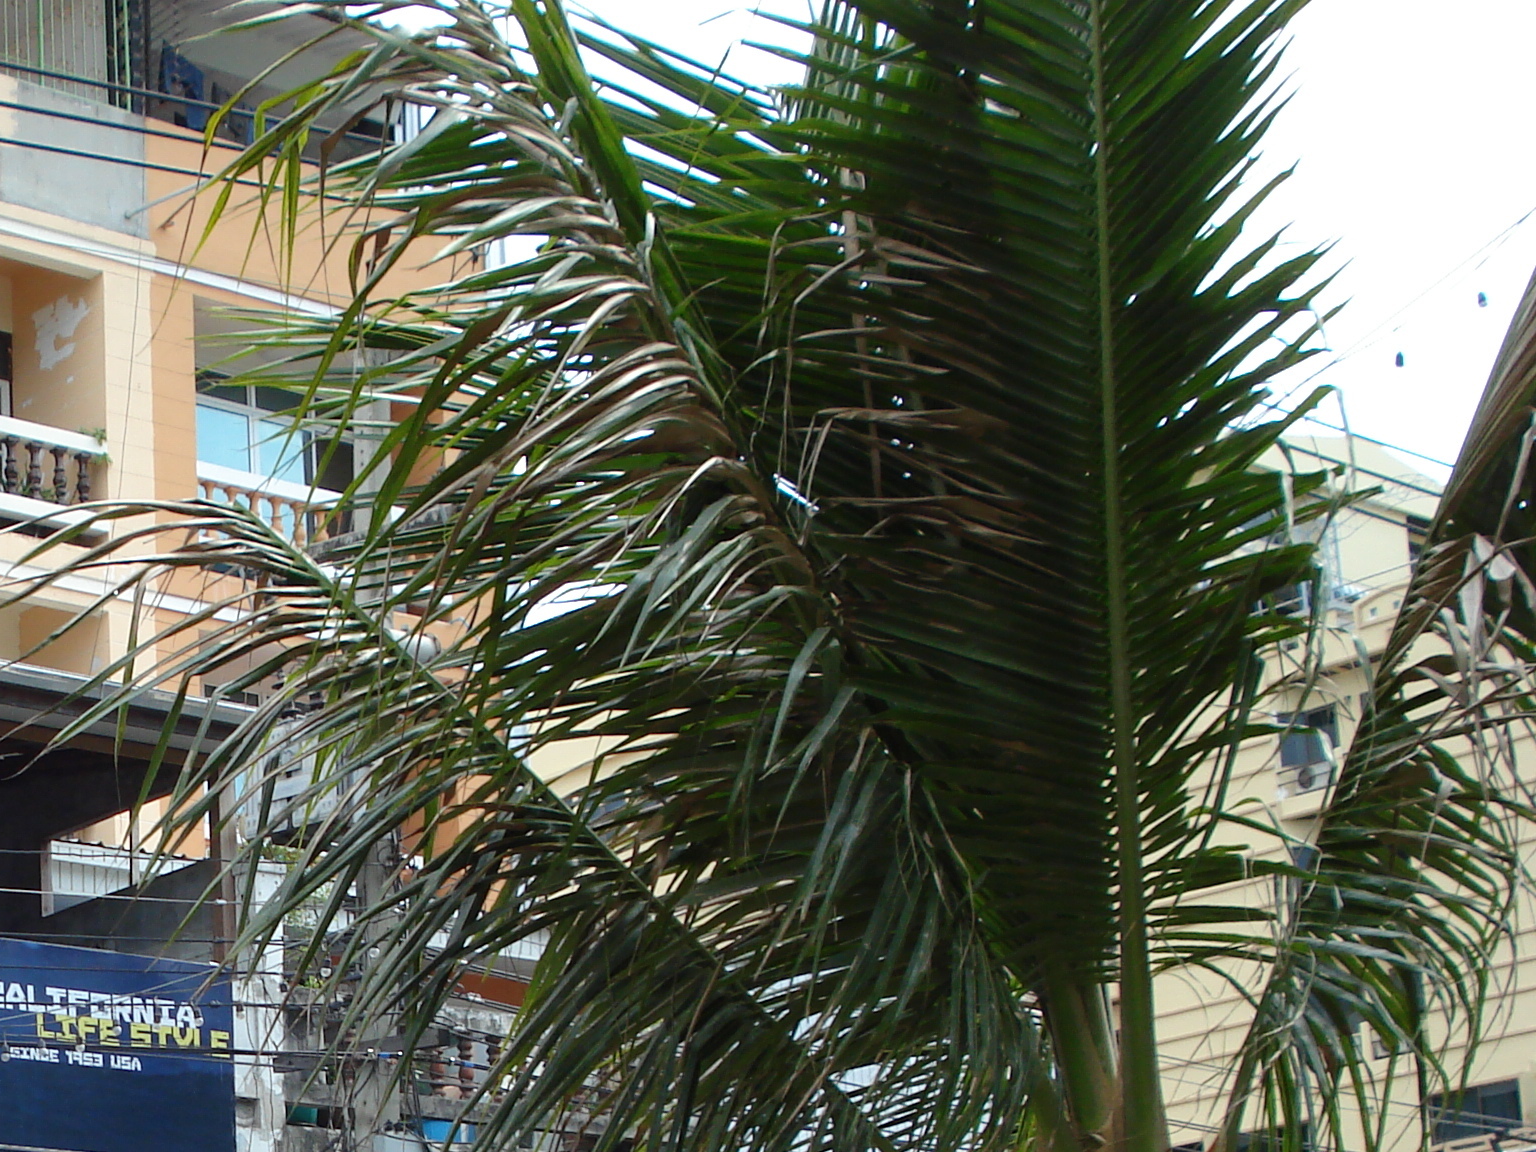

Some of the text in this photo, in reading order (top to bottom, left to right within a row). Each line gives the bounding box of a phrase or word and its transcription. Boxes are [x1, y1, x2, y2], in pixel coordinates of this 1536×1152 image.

[36, 1013, 231, 1058] LIFE STYLE
[10, 1047, 142, 1071] SINCE 1953 USA
